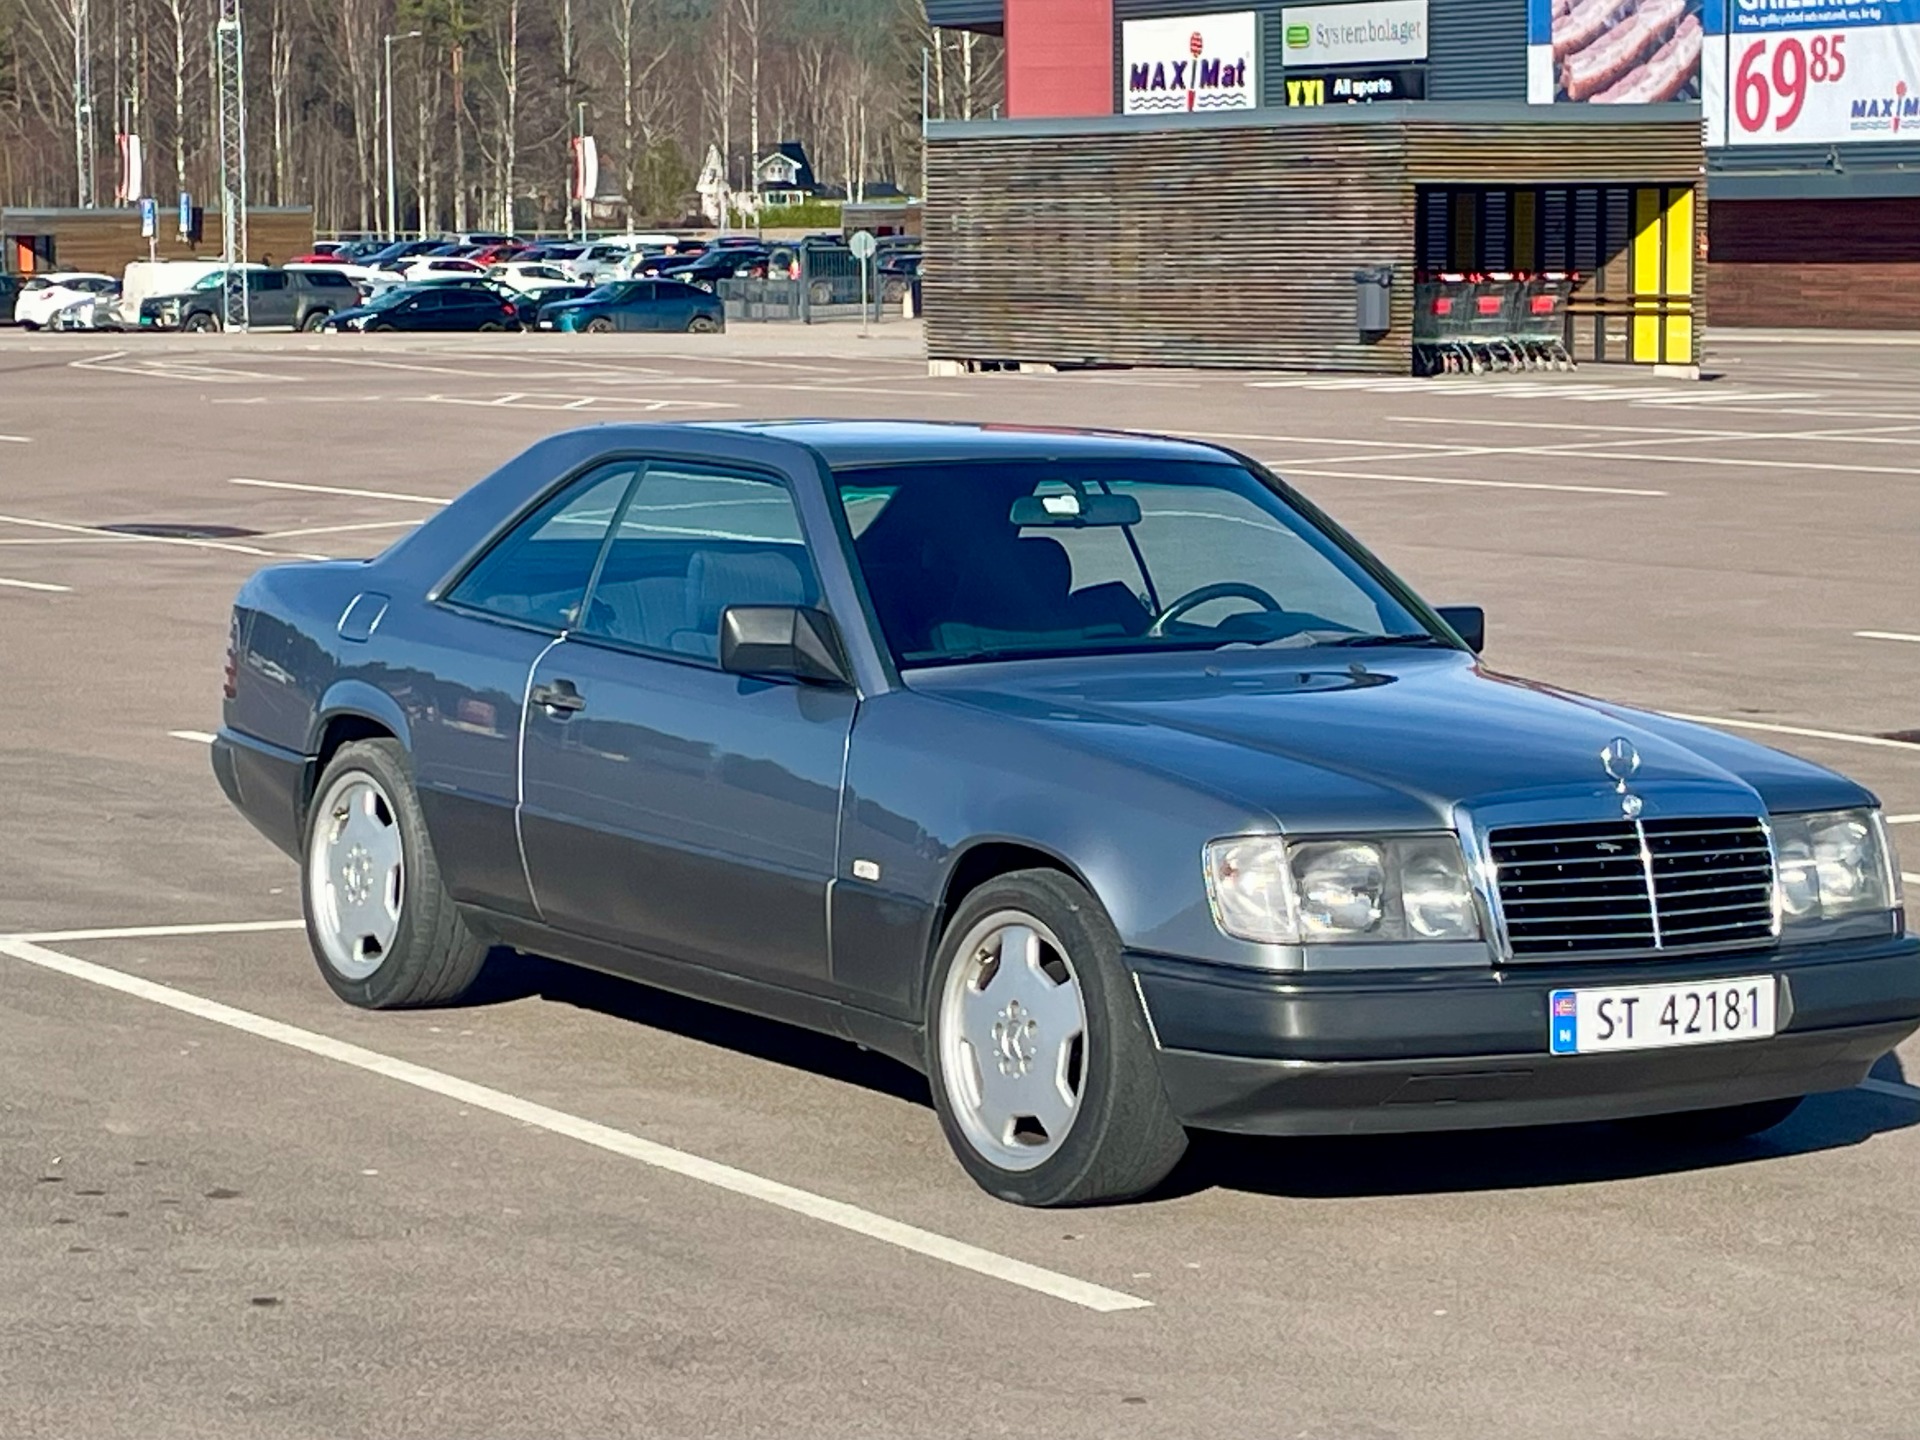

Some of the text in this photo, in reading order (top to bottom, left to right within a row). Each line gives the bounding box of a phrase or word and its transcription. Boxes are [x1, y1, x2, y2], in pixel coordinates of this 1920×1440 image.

[1316, 18, 1422, 48] Systembolaget
[1333, 78, 1351, 95] All
[1353, 77, 1393, 97] sports
[1596, 986, 1759, 1041] ST 42181
